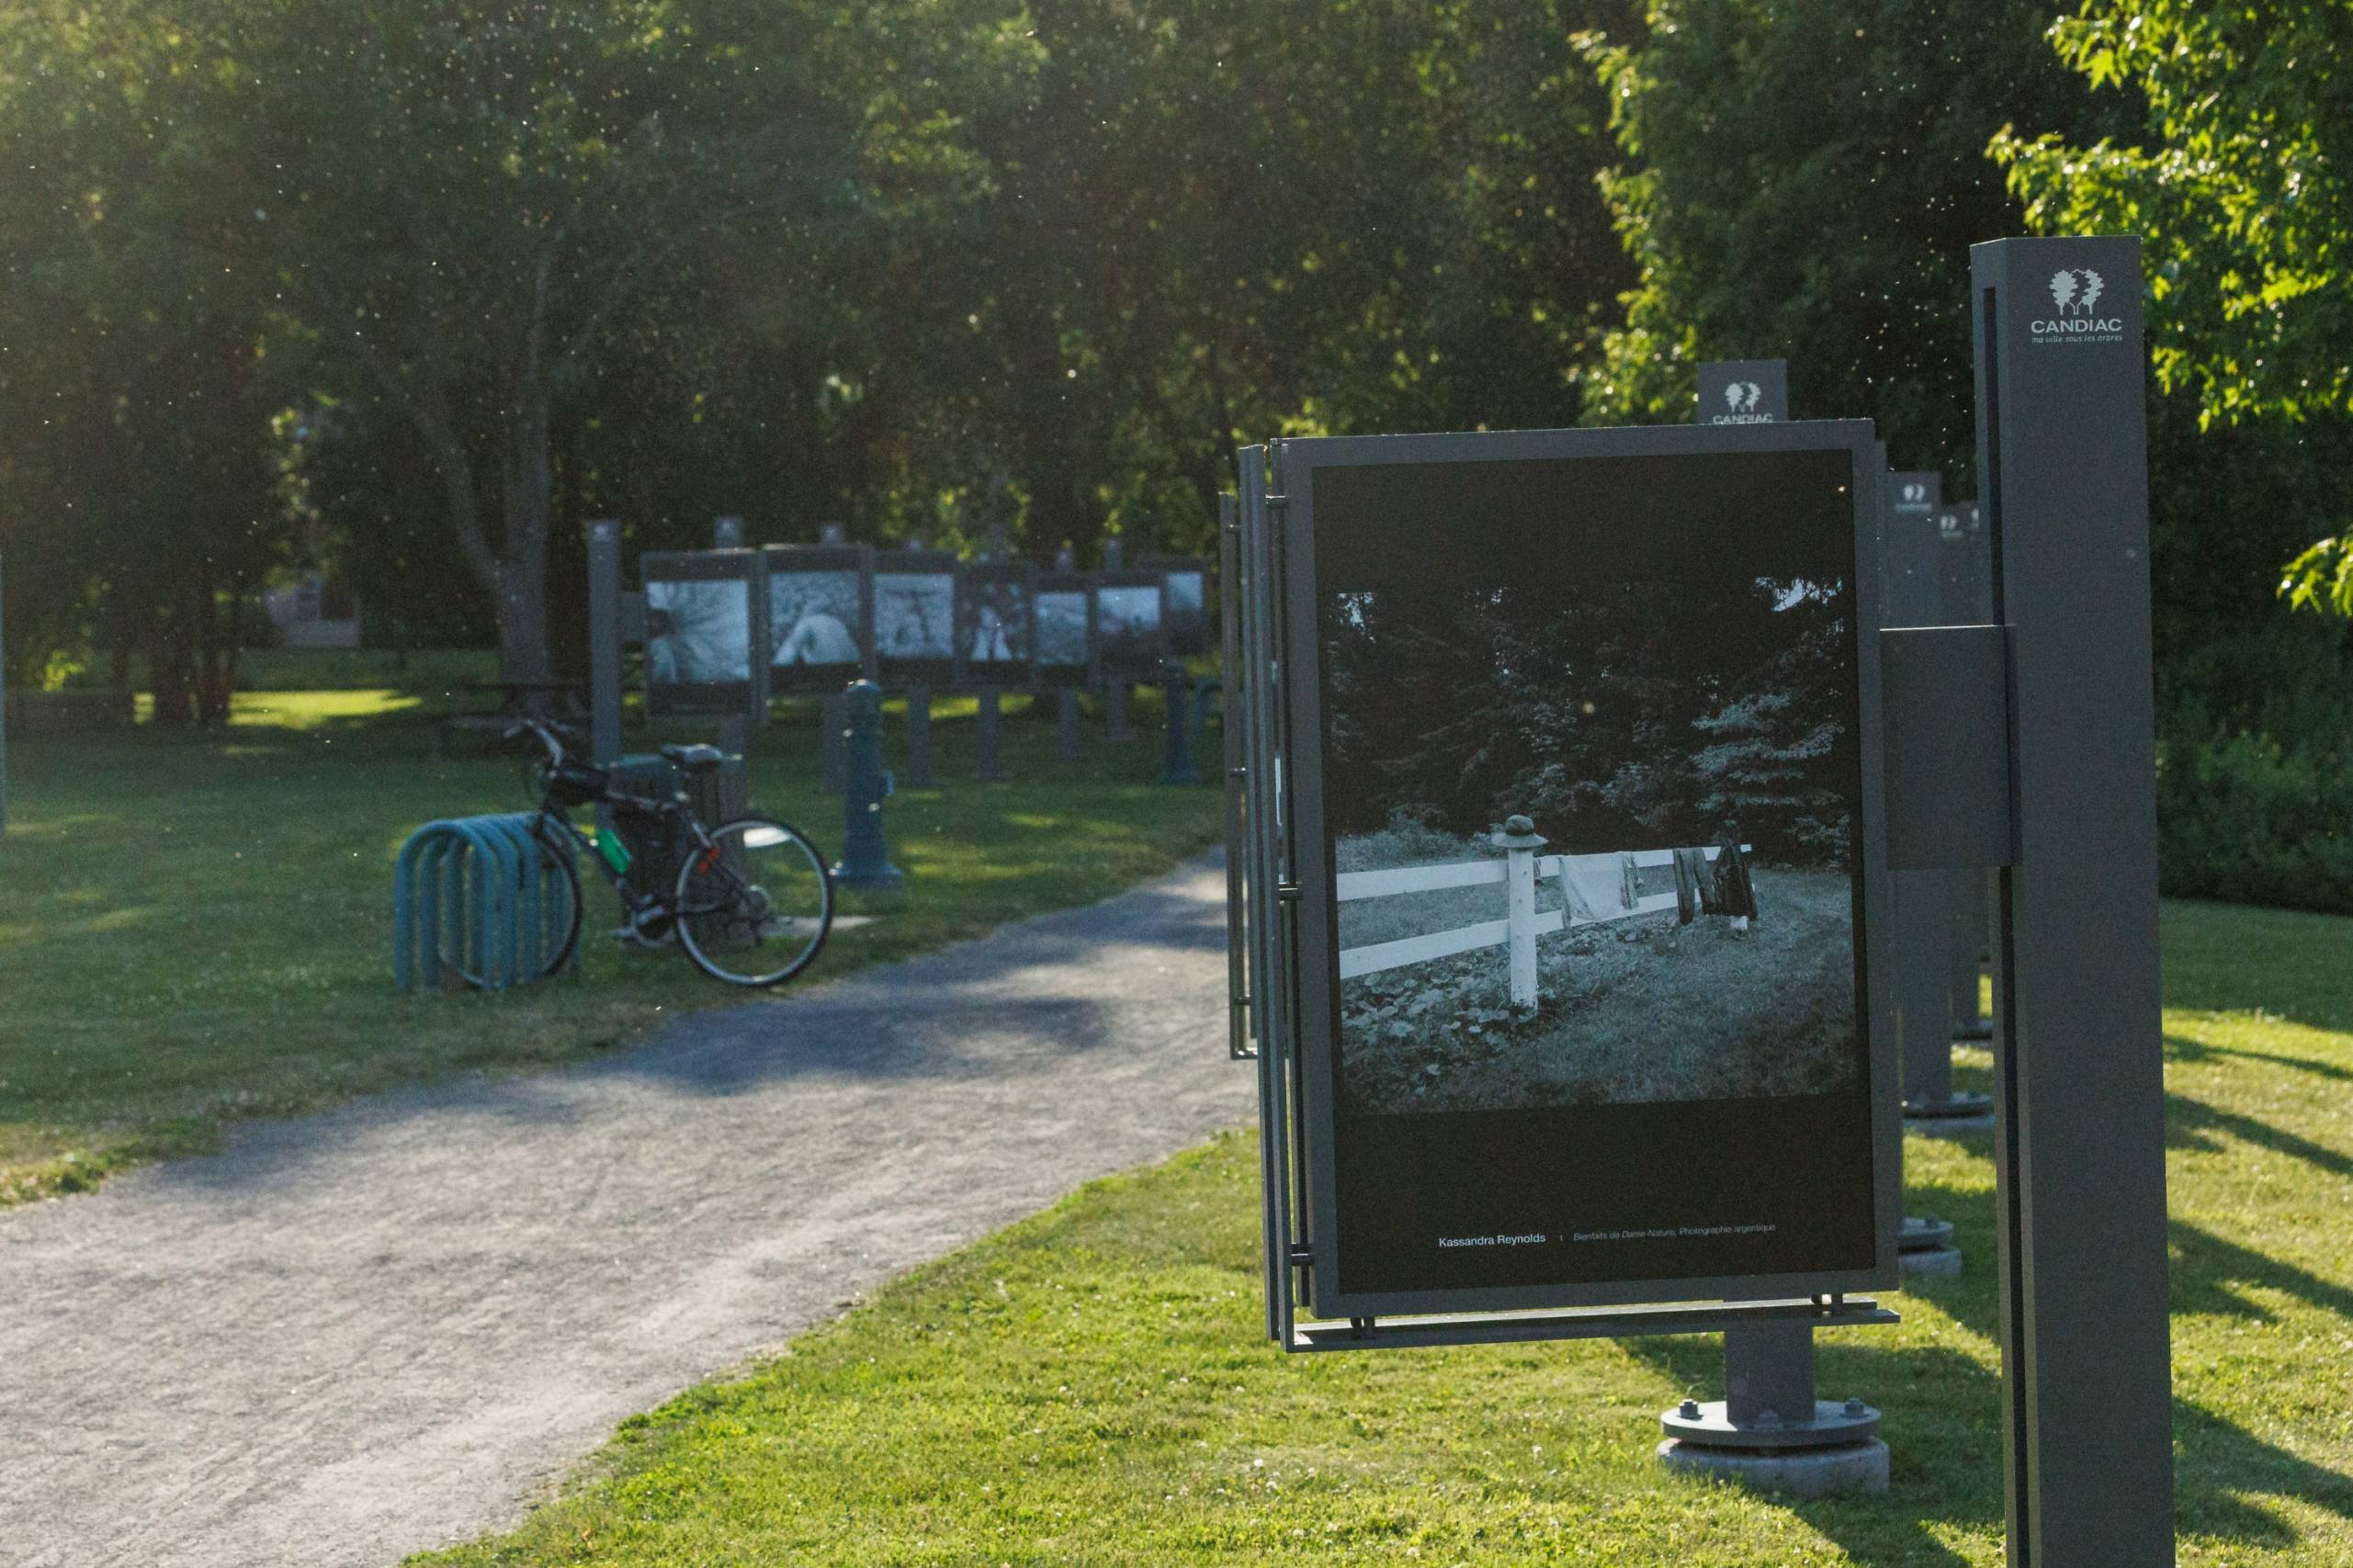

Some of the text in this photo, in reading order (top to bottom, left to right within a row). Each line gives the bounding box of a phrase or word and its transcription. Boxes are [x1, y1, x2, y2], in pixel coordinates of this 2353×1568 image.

[2031, 318, 2122, 333] CANDIAC
[2045, 335, 2064, 344] ville
[2097, 333, 2123, 342] arbres
[1713, 412, 1774, 423] CANDIAC
[1439, 1235, 1495, 1247] Kassandra
[1497, 1233, 1546, 1246] Reynolds
[1679, 1224, 1732, 1236] Photographie
[1734, 1224, 1776, 1235] argentique
